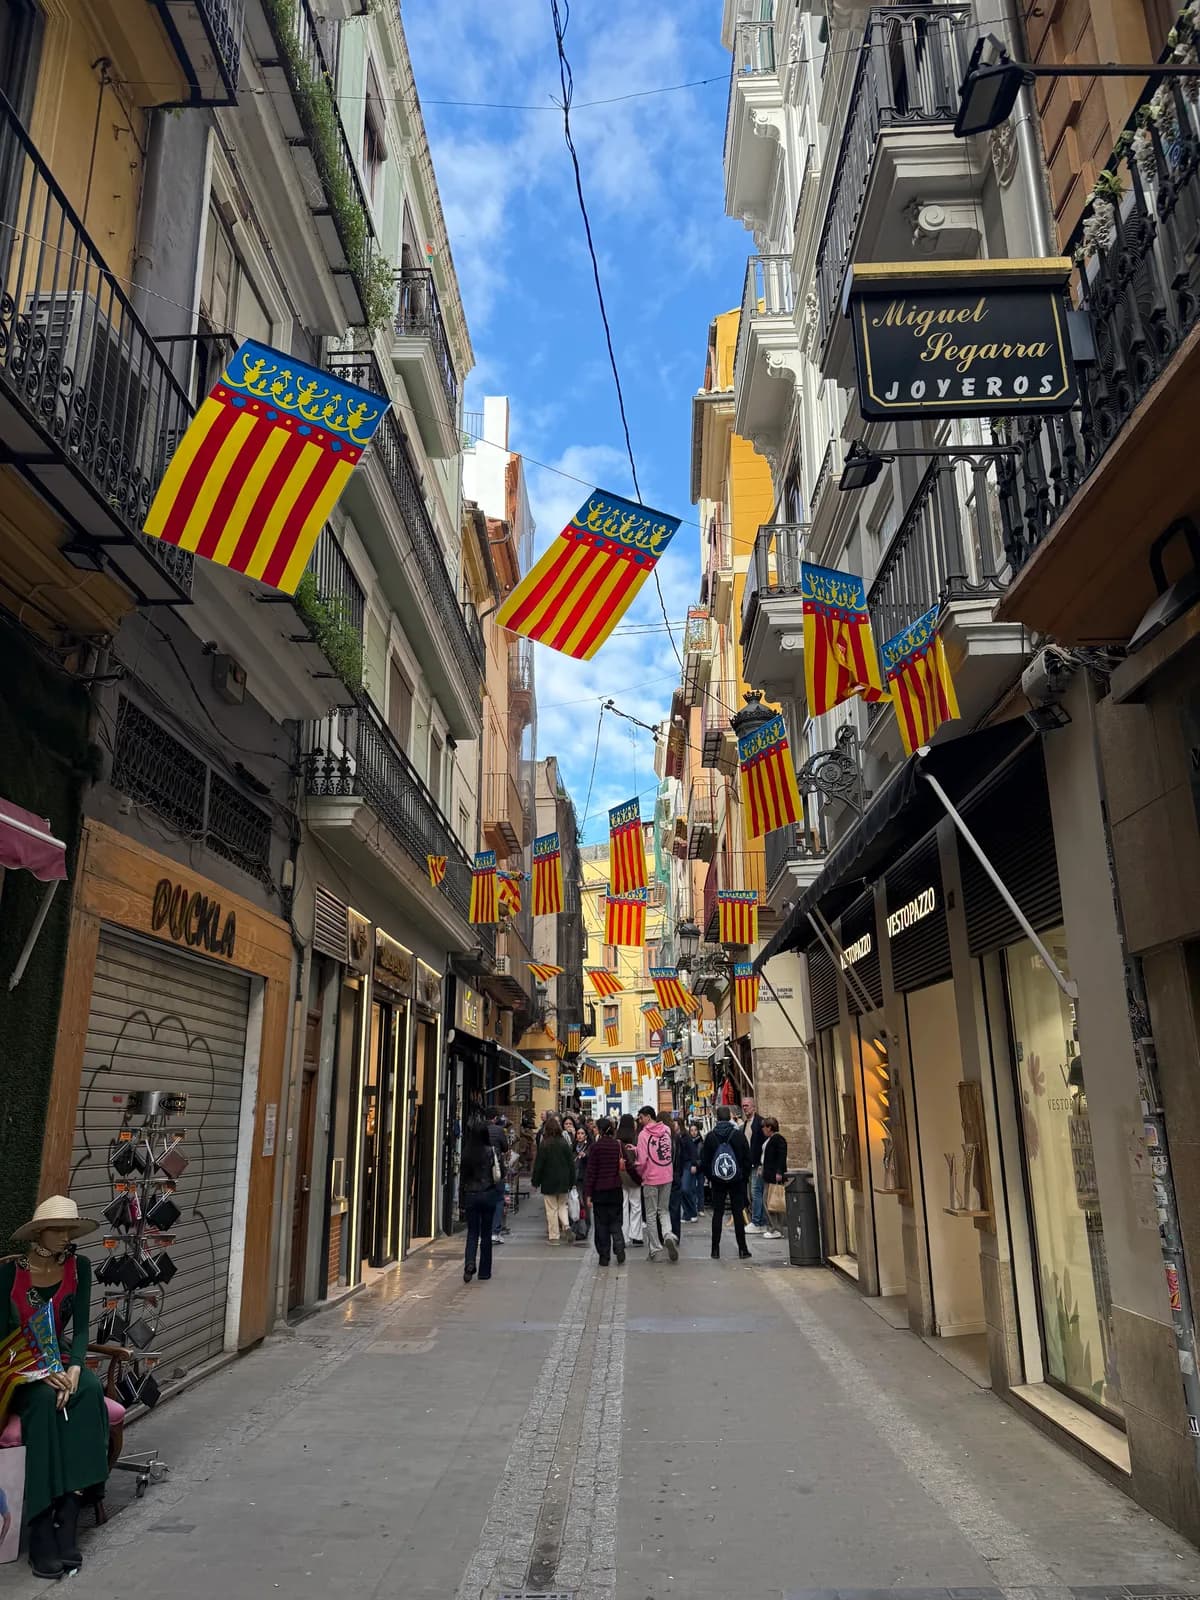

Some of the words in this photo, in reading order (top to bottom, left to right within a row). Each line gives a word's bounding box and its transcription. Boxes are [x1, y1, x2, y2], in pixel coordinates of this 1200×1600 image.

[872, 296, 990, 337] Miguel
[920, 332, 1053, 373] Segarra
[885, 375, 1054, 401] JOYEROS
[886, 886, 935, 938] VESTOPAZZO
